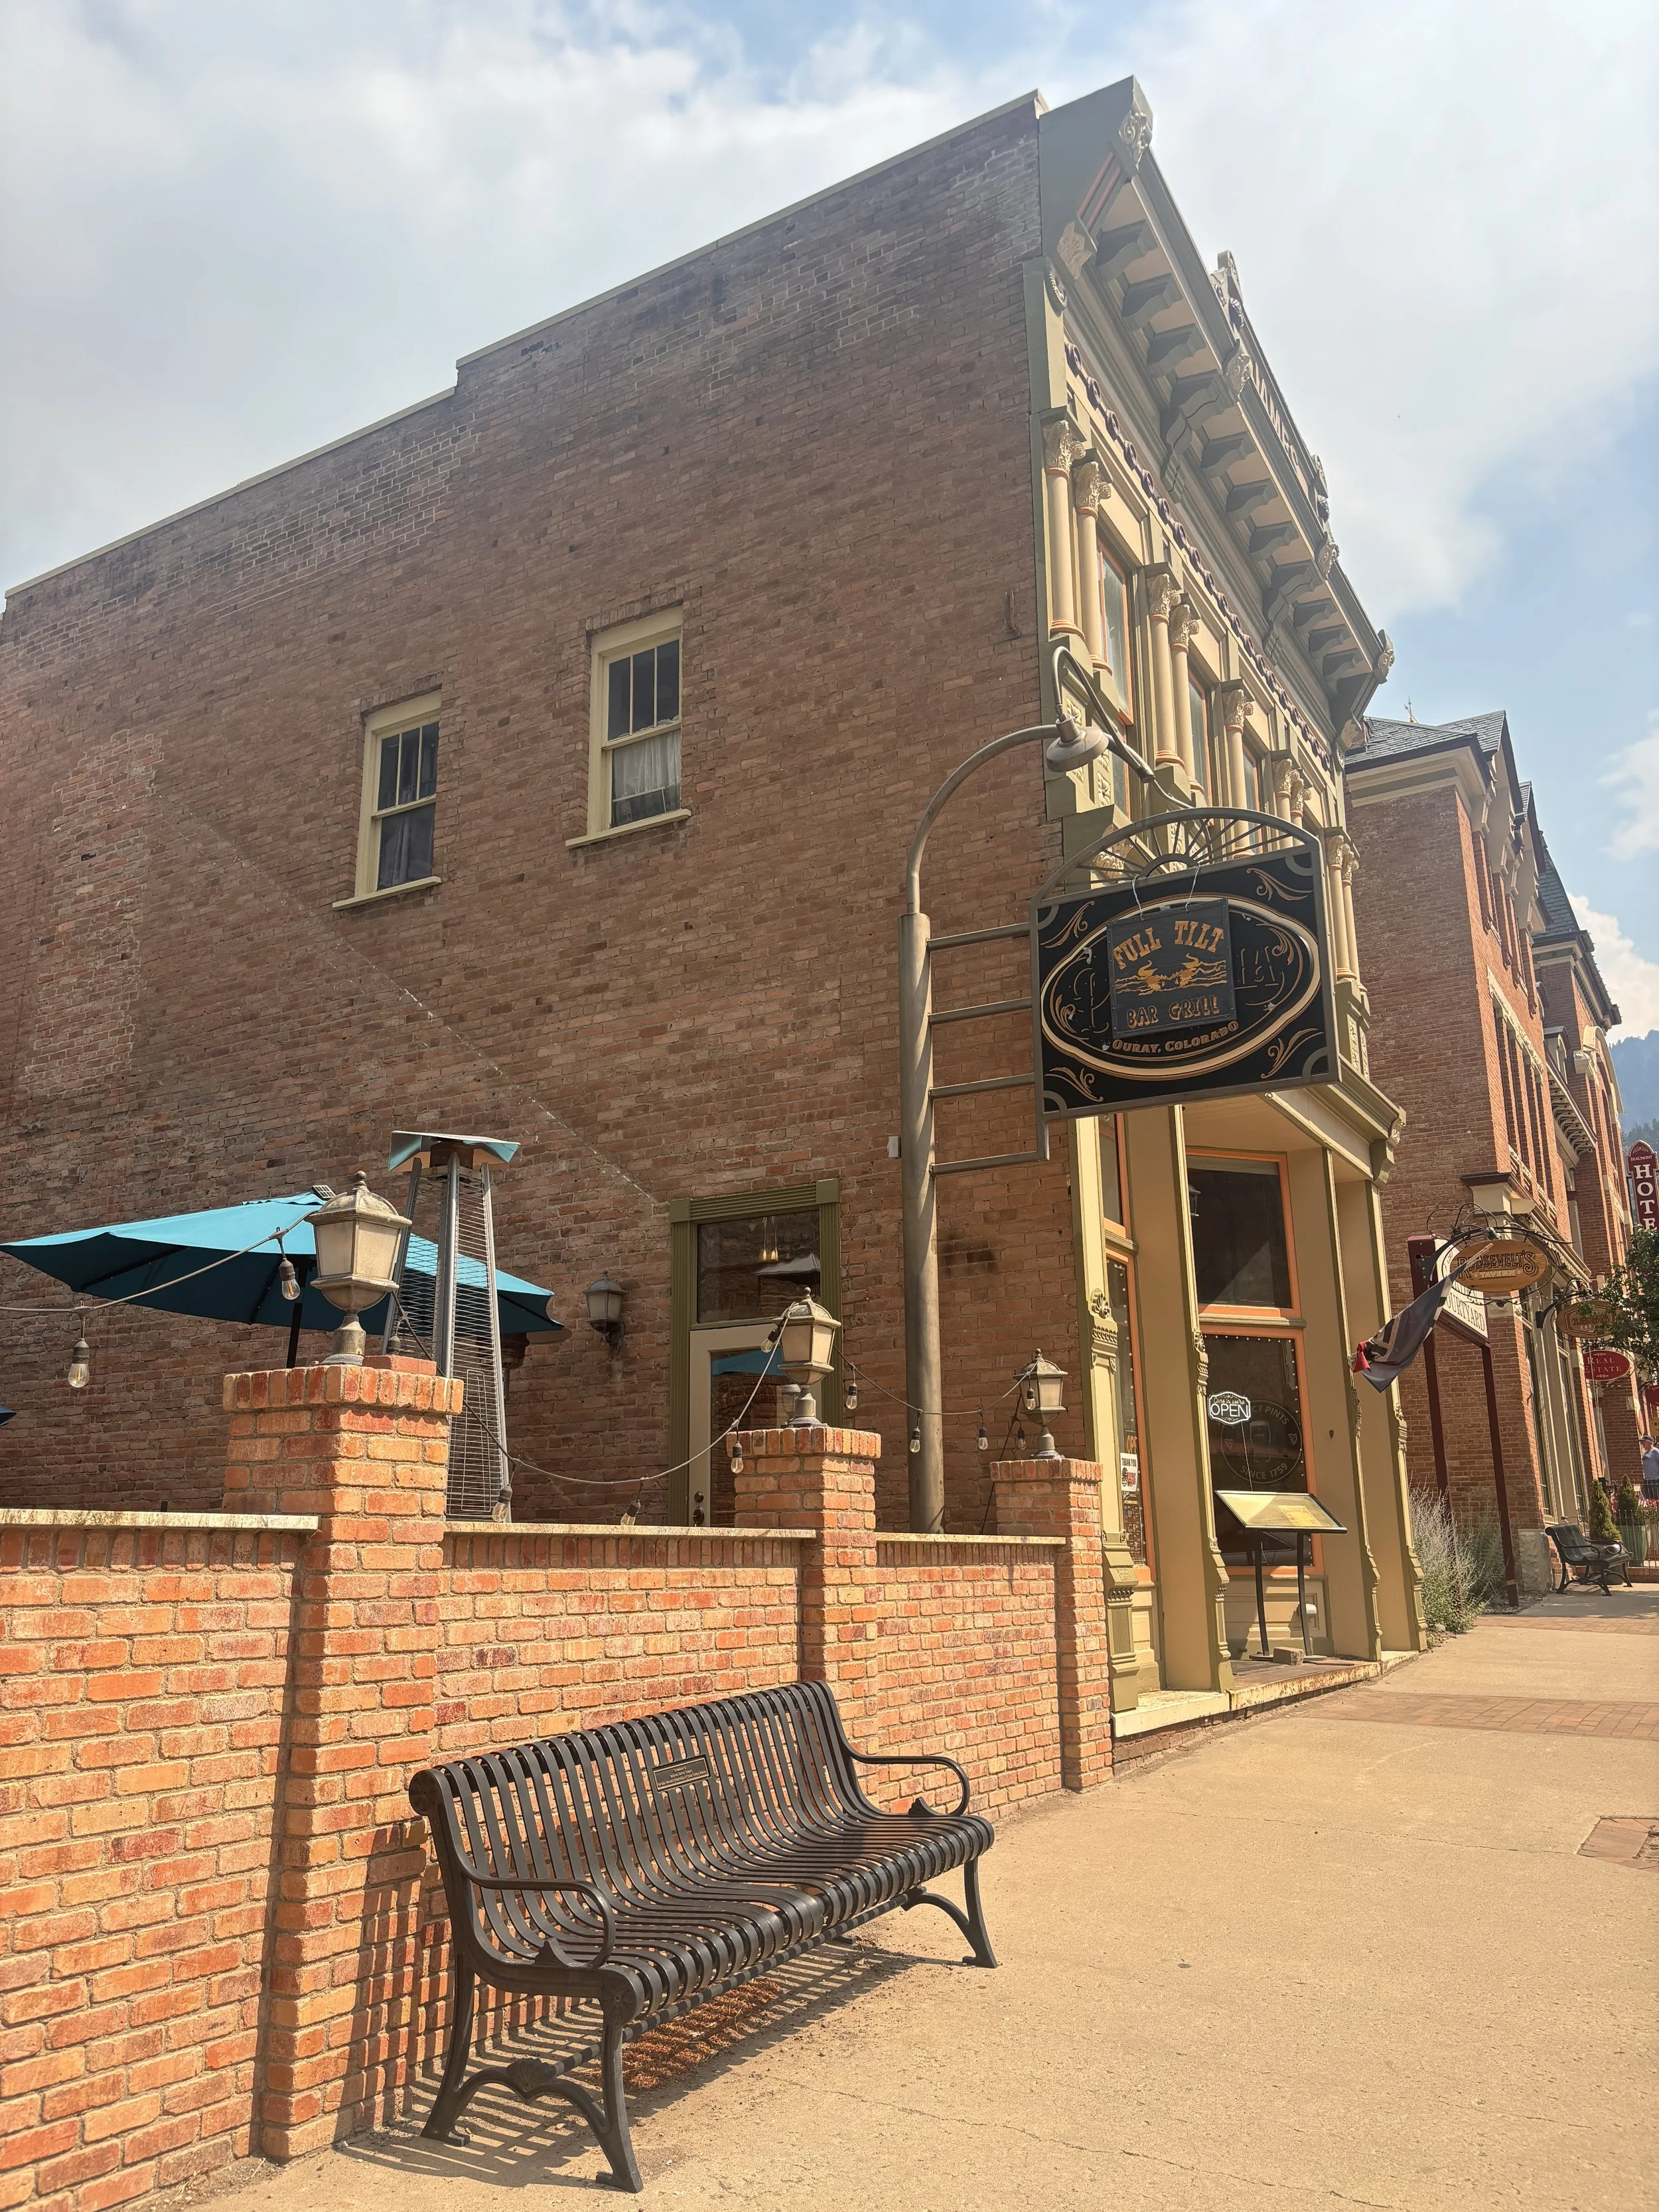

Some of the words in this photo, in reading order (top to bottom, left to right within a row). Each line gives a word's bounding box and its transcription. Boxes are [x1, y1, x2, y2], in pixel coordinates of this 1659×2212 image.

[1113, 926, 1162, 970] FULL
[1175, 920, 1224, 953] TILT
[1127, 1005, 1158, 1029] BAR
[1169, 995, 1220, 1021] GRILL
[1112, 1038, 1161, 1053] OURAY,
[1165, 1020, 1239, 1053] COLORADO
[1633, 1163, 1658, 1231] HOTE
[1447, 1292, 1485, 1331] OURTYARD
[1210, 1403, 1248, 1418] OPEN
[1265, 1406, 1289, 1425] PINTS
[1240, 1465, 1267, 1479] SINCE
[1269, 1463, 1287, 1479] 1759
